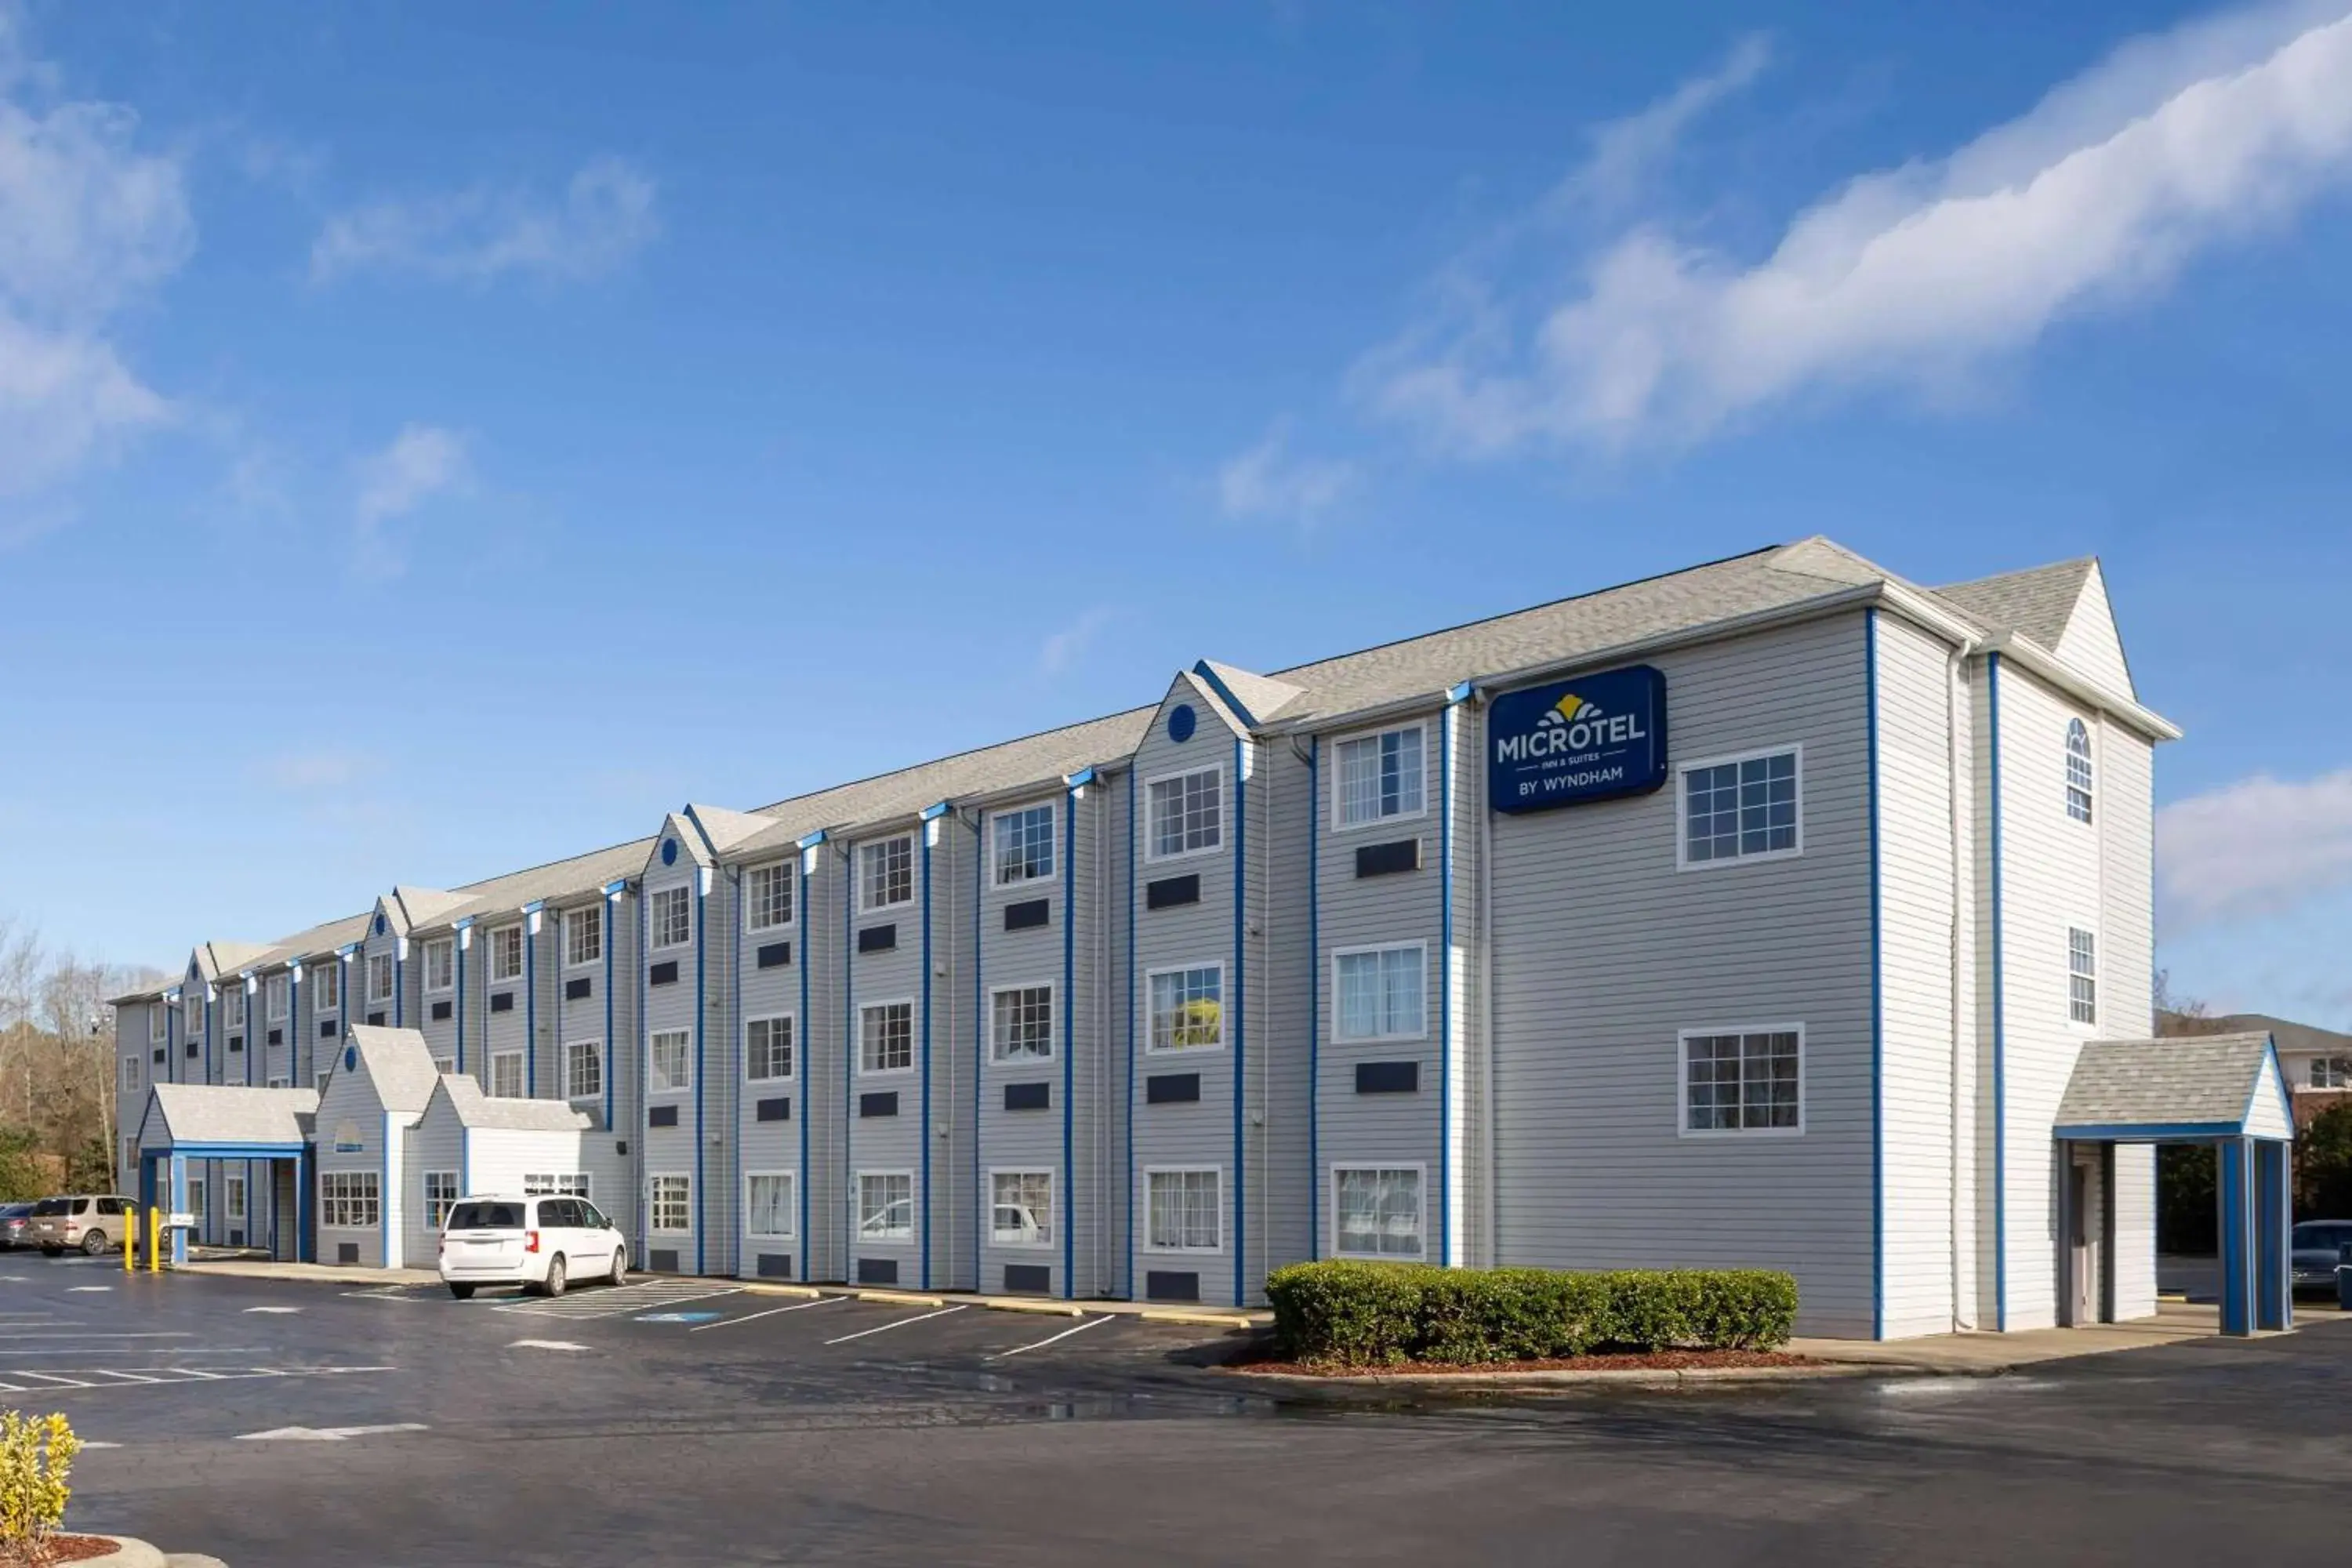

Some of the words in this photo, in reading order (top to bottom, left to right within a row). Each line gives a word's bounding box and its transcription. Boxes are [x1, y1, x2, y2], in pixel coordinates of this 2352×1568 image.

[1497, 713, 1646, 763] MICROTEL
[1541, 760, 1558, 770] INN
[1568, 753, 1600, 766] SUITES
[1519, 781, 1537, 796] BY
[1544, 766, 1624, 790] WYNDHAM
